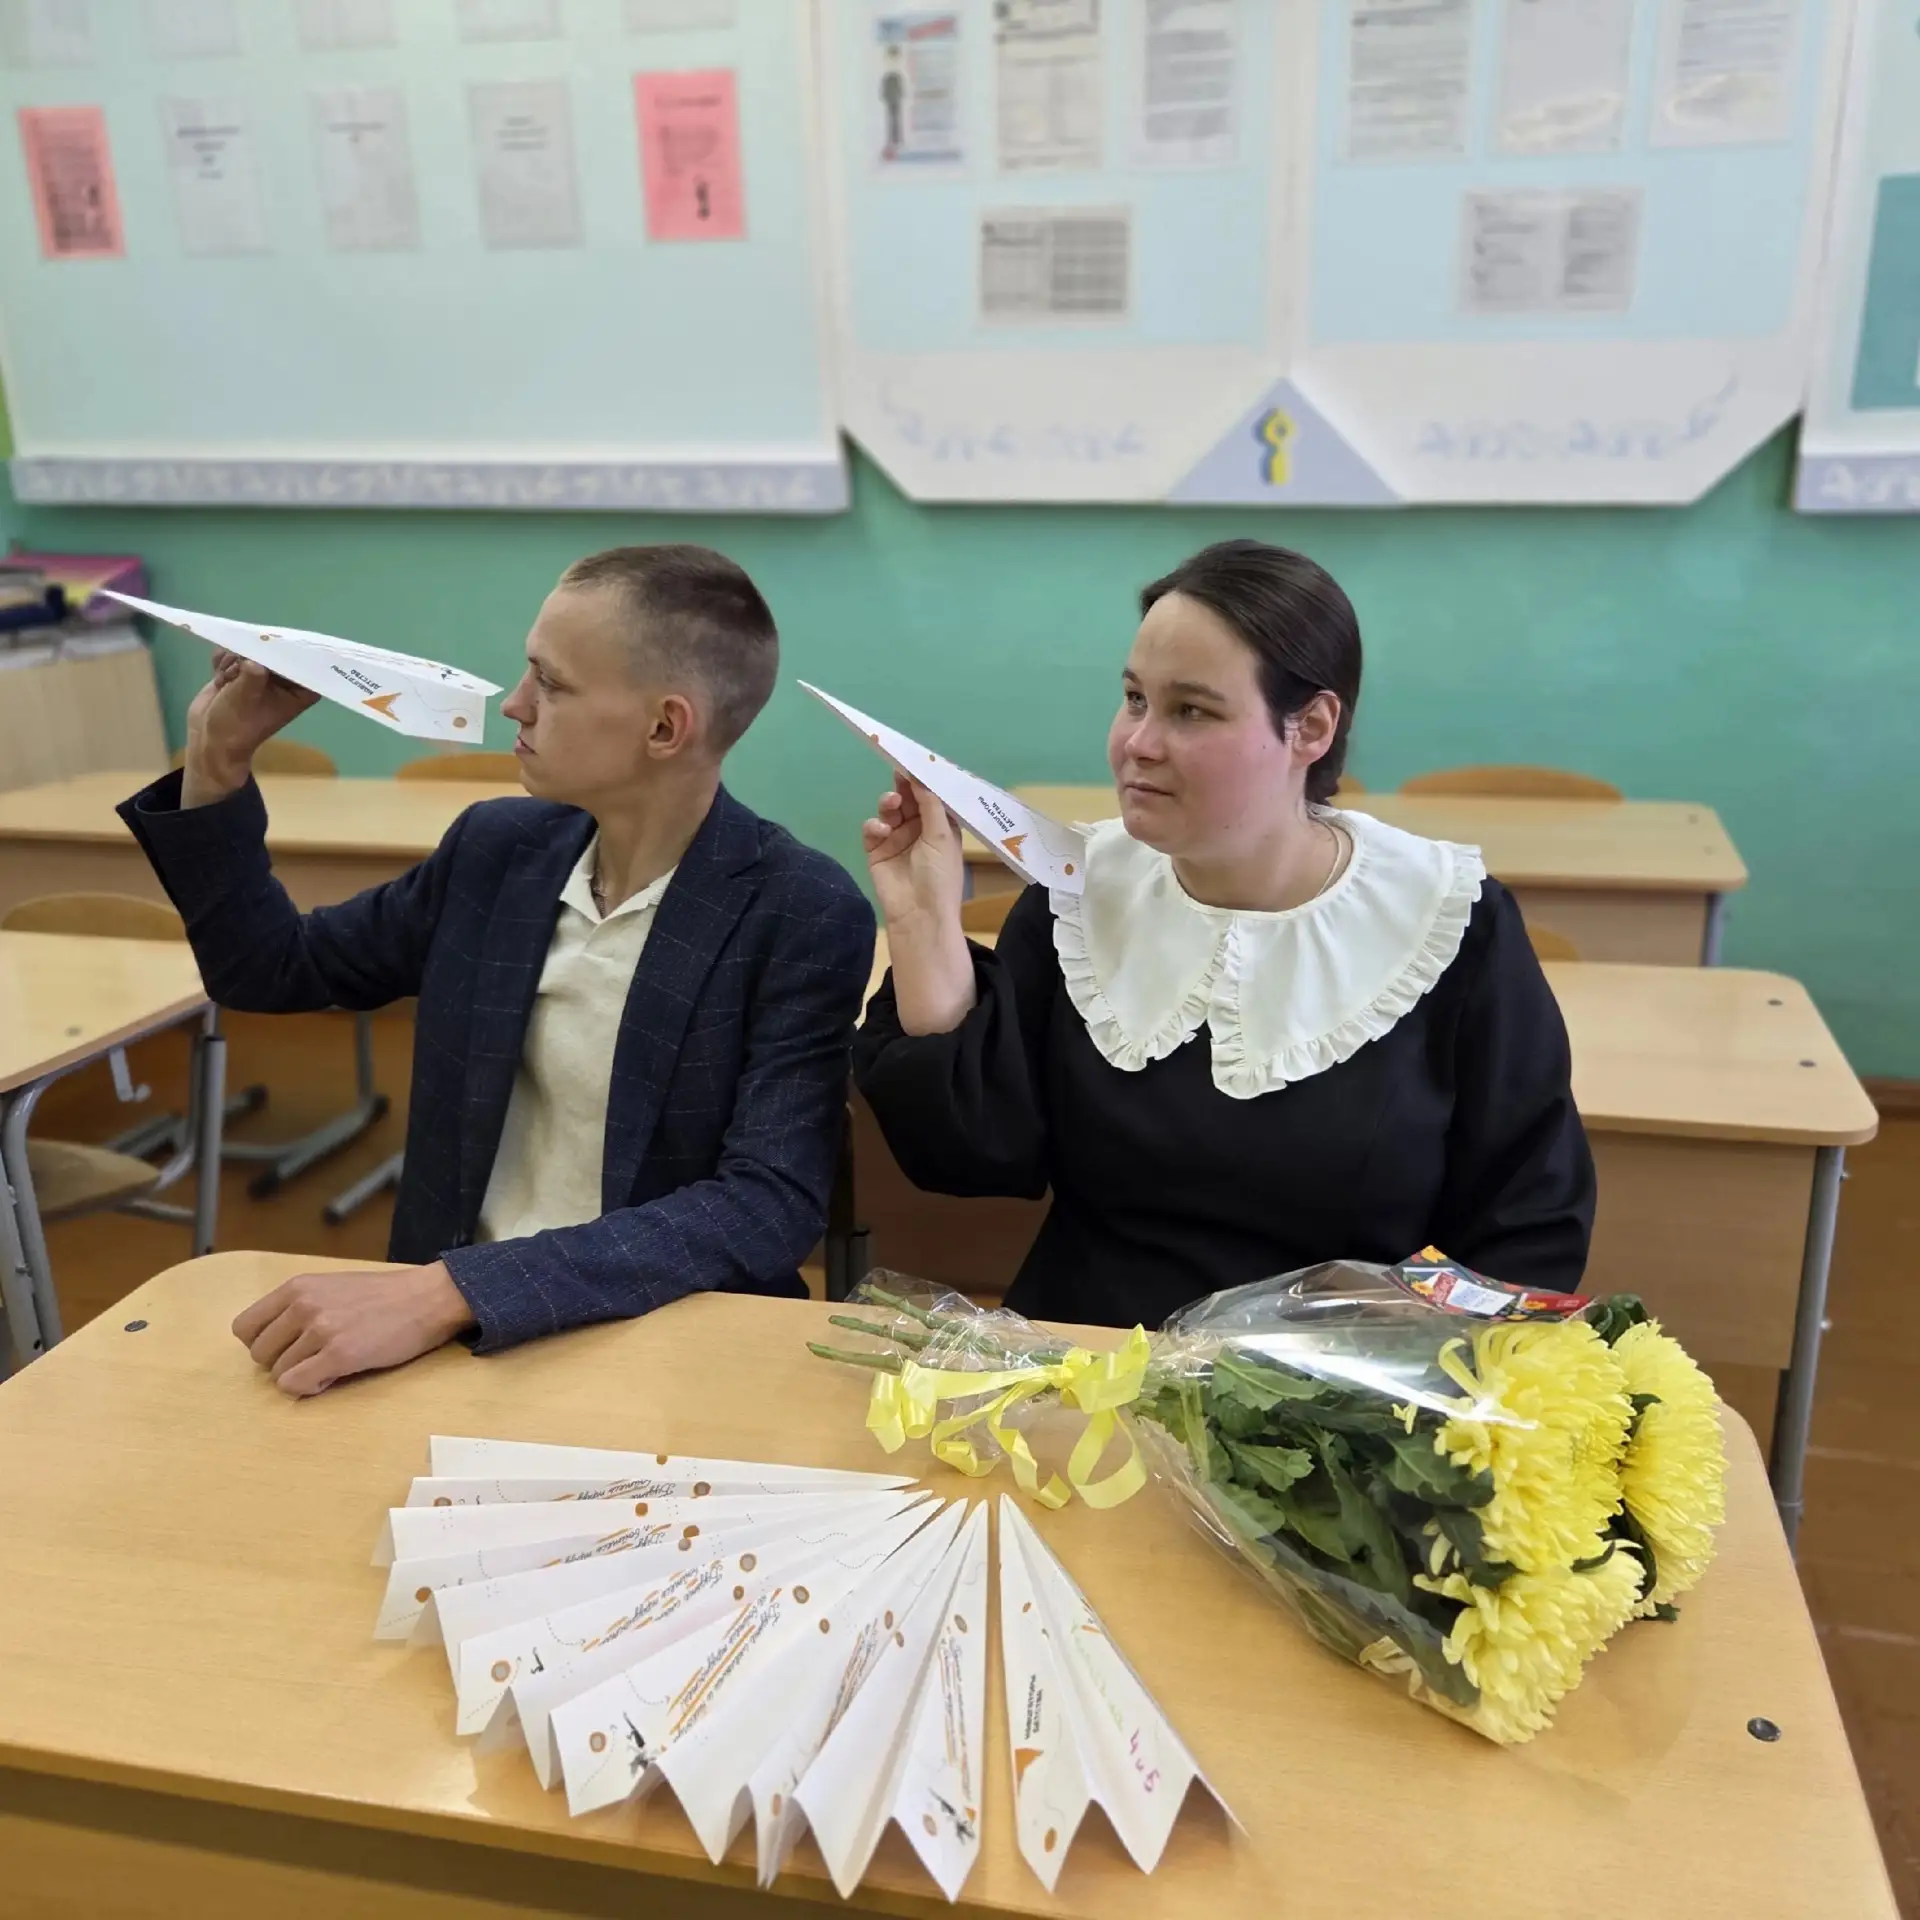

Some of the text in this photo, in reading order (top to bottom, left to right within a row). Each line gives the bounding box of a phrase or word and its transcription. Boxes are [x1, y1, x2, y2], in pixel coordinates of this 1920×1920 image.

[330, 664, 374, 695] НАВИГАТОРЫ
[977, 796, 1010, 833] НАВИГАТОРЫ
[992, 802, 1016, 828] ДЕТСТВА
[1129, 1727, 1140, 1756] 4
[1143, 1768, 1161, 1793] 5
